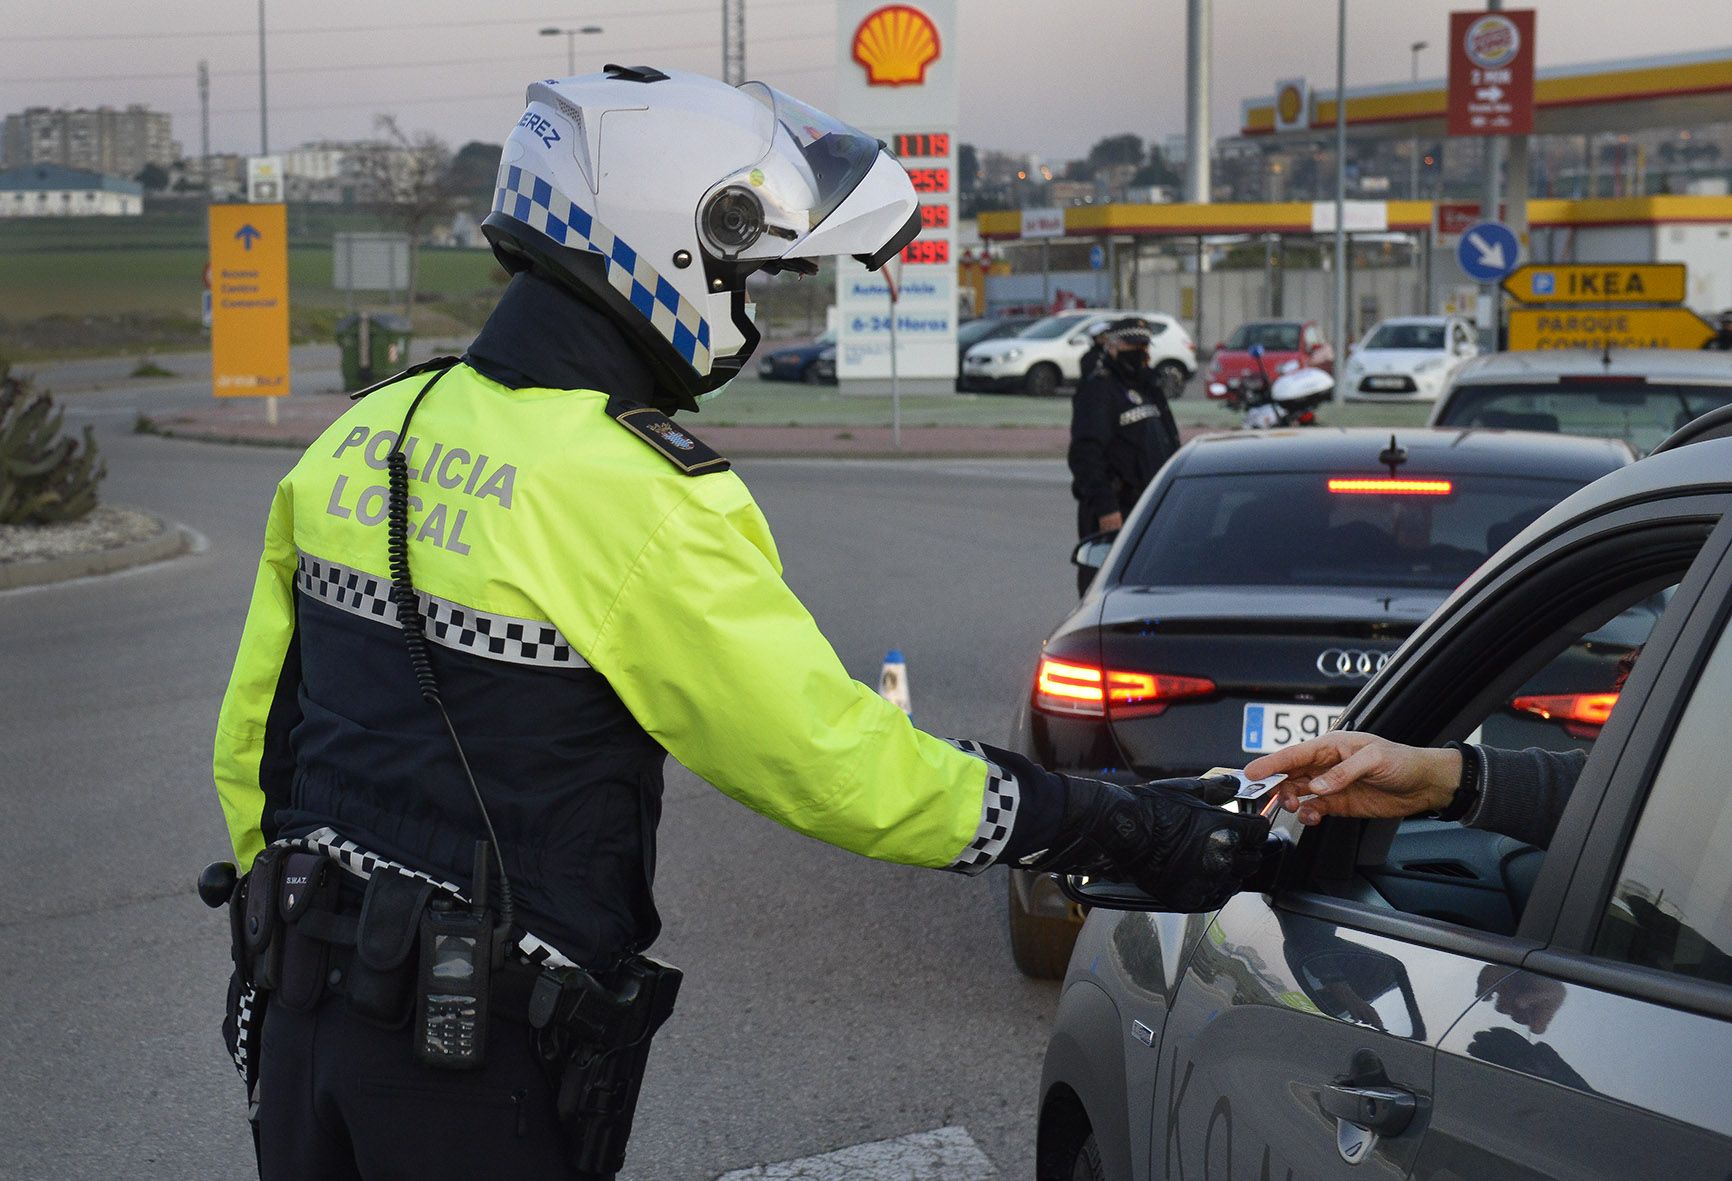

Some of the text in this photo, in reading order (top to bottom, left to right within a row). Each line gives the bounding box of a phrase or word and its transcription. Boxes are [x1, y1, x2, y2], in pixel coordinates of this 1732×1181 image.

[1569, 272, 1645, 295] IKEA
[1537, 316, 1629, 333] PARQUE
[332, 426, 517, 510] POLICIA
